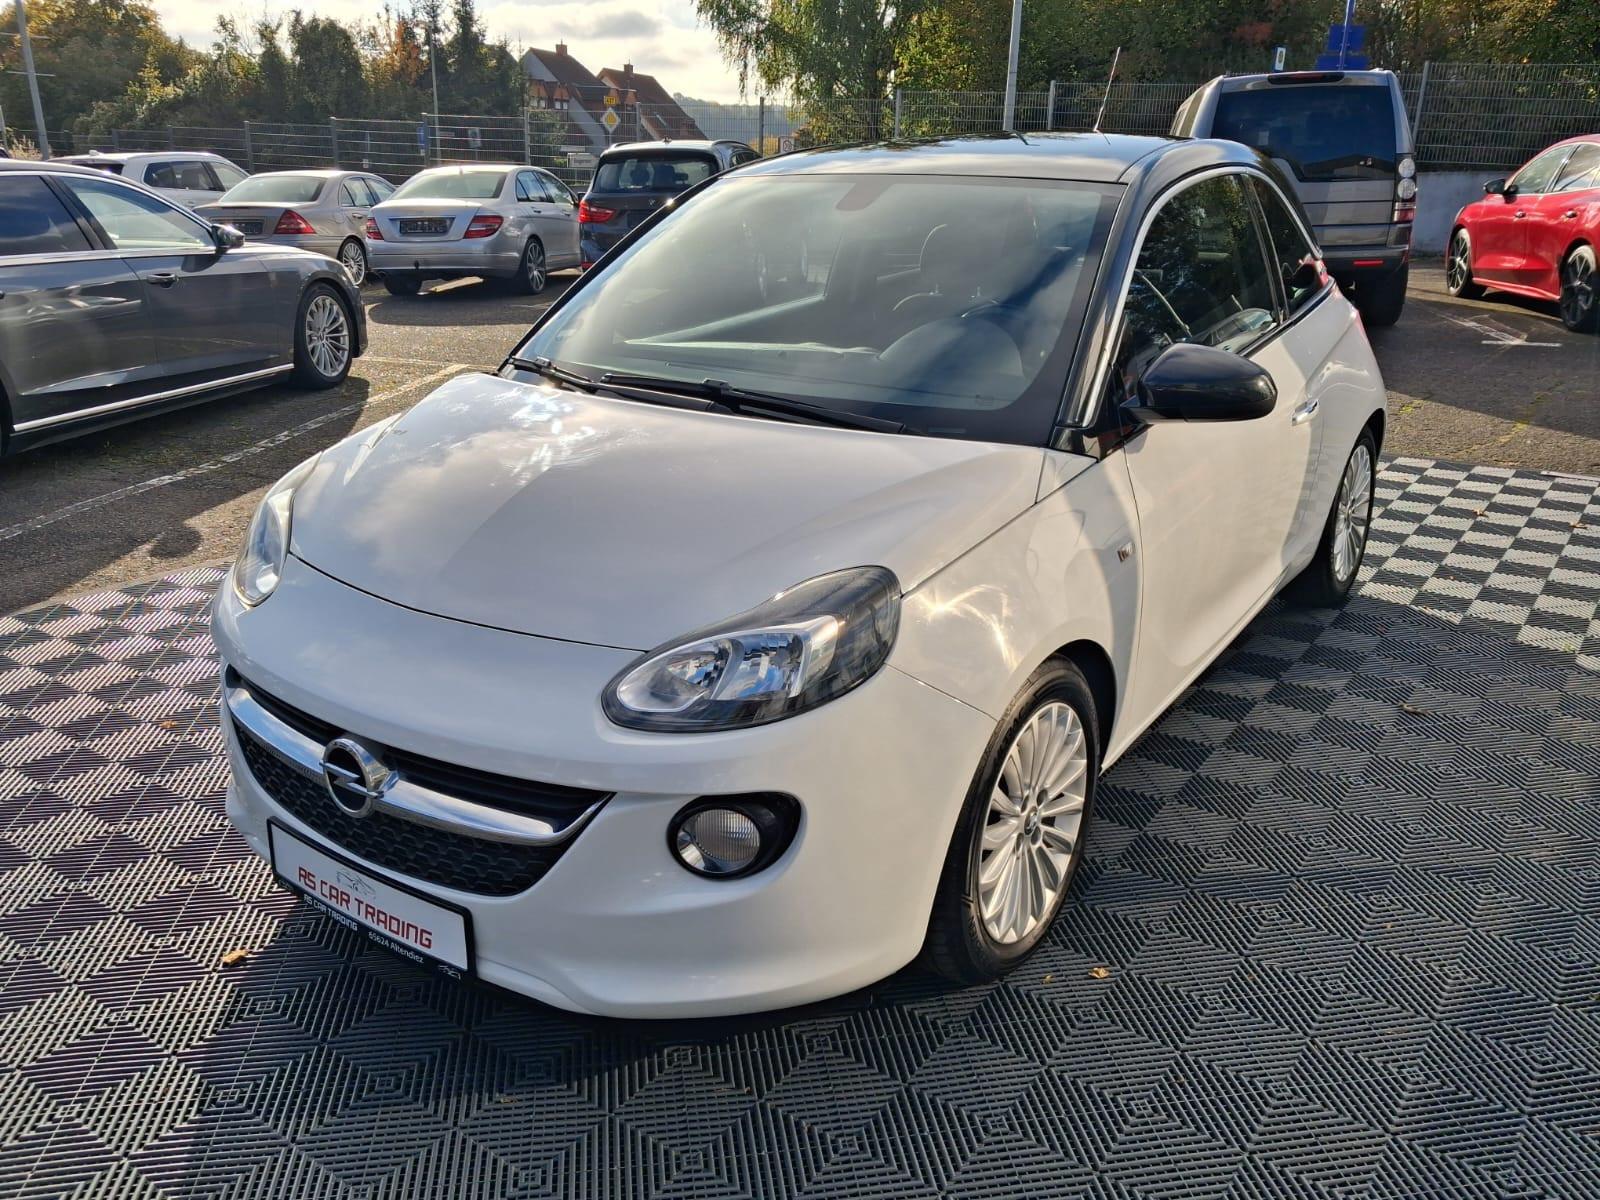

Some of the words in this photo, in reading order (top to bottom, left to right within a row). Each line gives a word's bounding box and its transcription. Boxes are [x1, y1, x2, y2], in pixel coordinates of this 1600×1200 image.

[298, 866, 316, 891] RS
[320, 879, 351, 912] CAR
[354, 898, 433, 949] TRADING
[313, 899, 327, 914] CAR
[328, 908, 358, 932] TRADING
[390, 943, 424, 964] Altendiez
